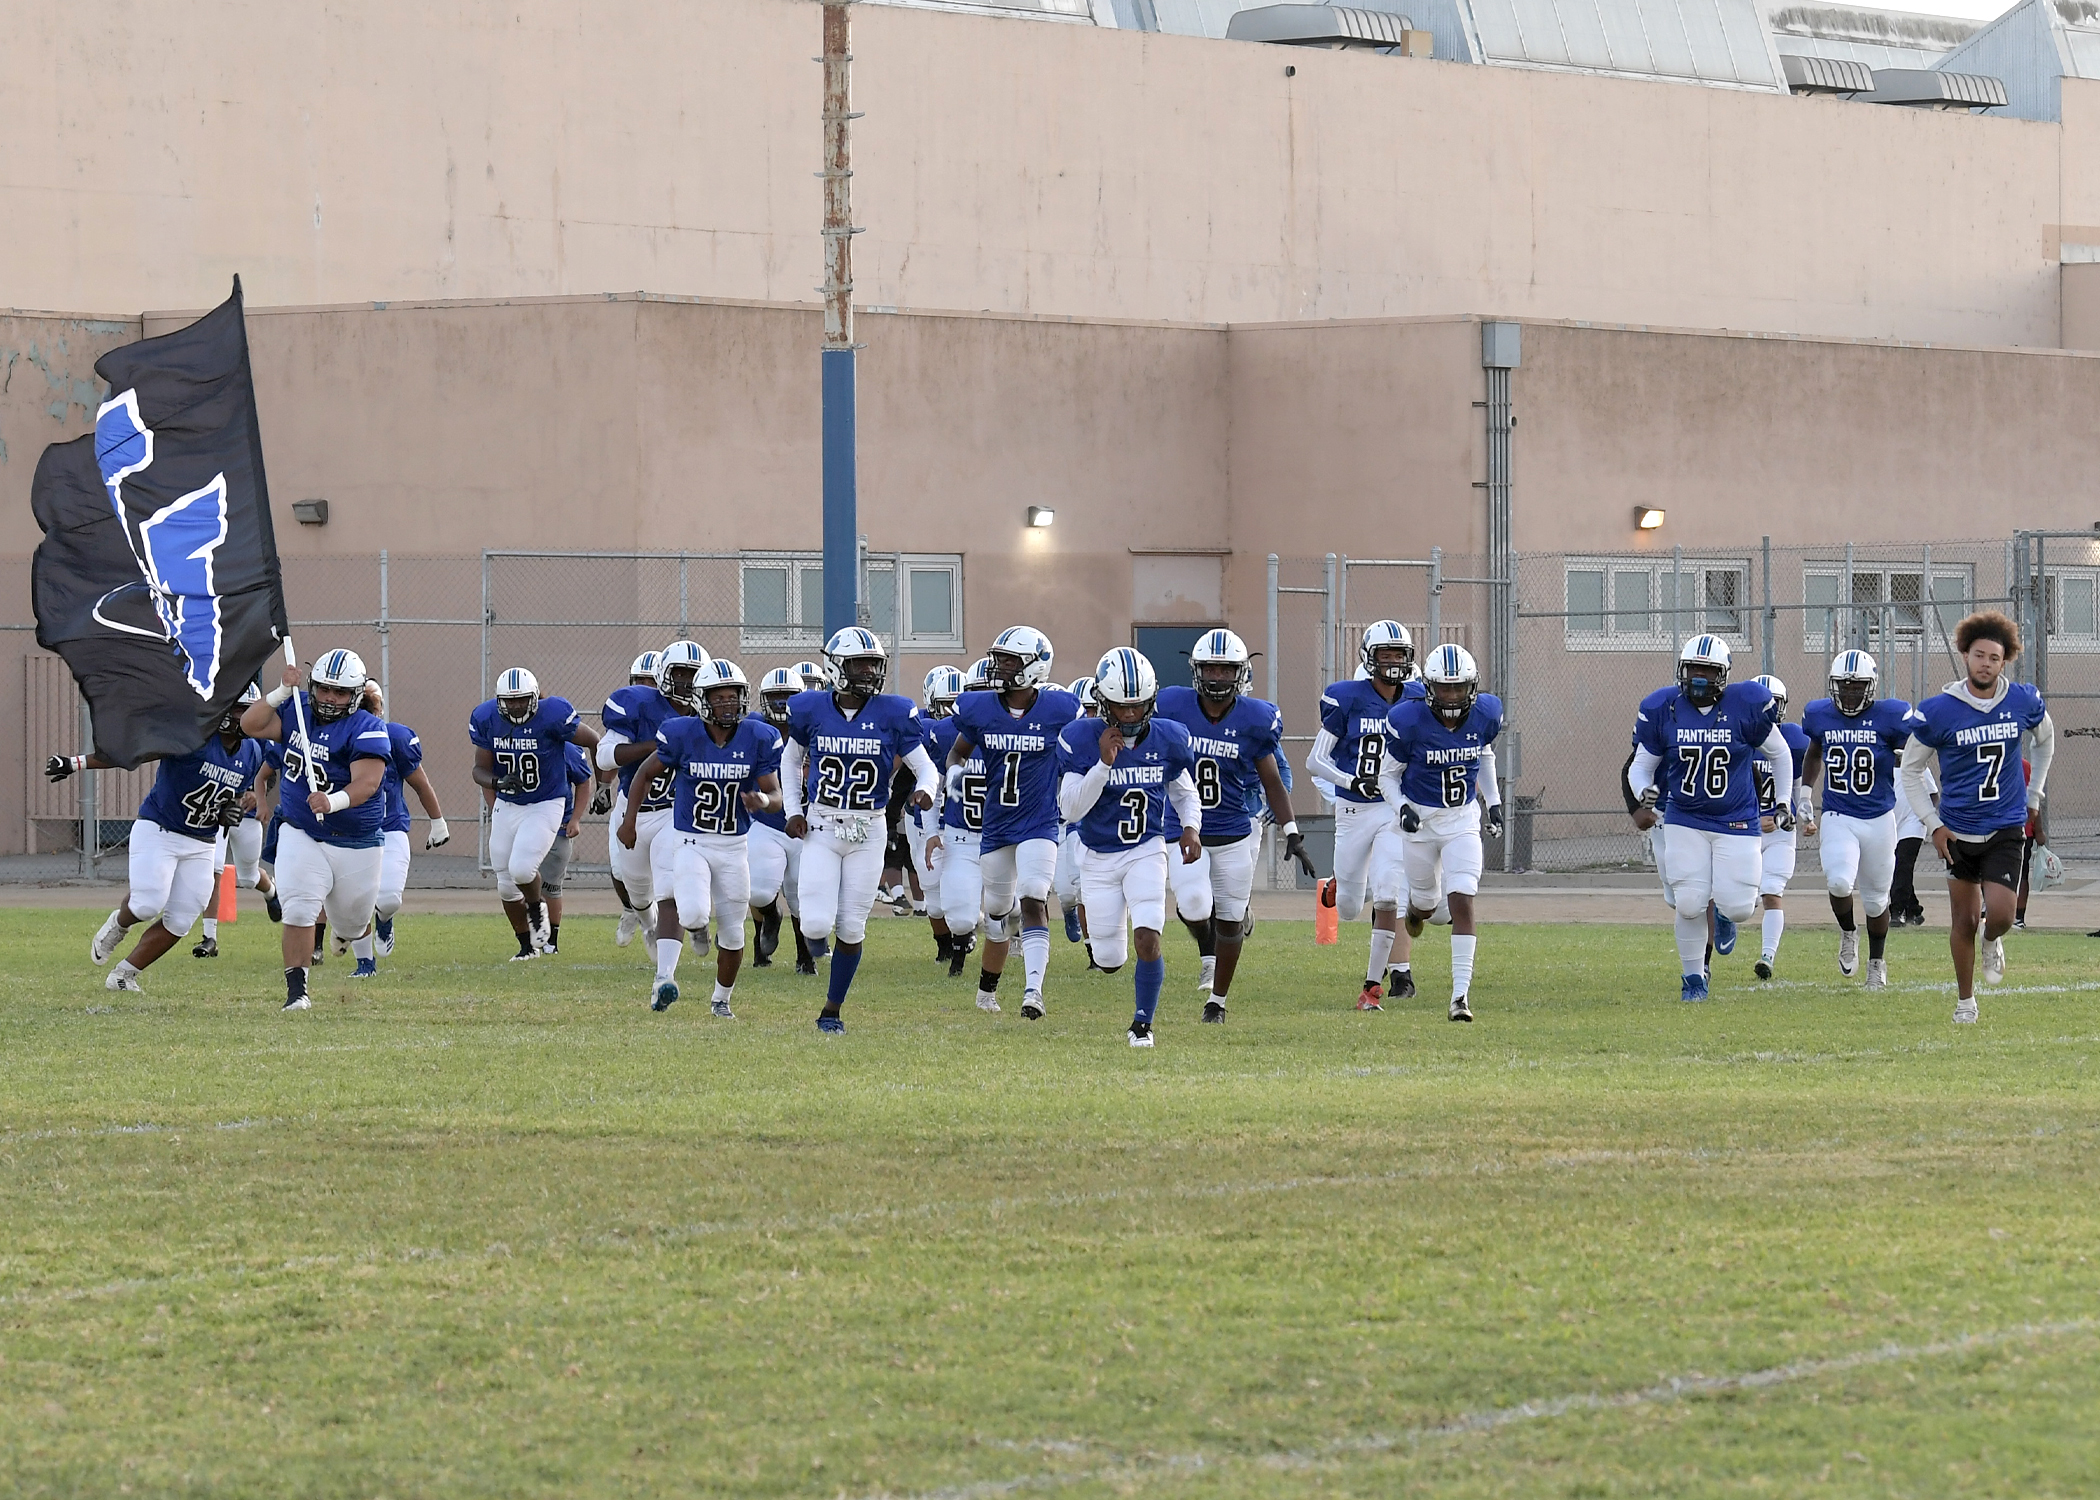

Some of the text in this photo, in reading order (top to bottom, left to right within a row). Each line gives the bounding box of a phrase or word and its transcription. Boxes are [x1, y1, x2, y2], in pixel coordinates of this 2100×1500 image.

[816, 735, 882, 756] PANTHERS
[983, 733, 1046, 752] PANTHERS
[1193, 735, 1240, 760] NTHERS
[1676, 728, 1732, 743] PANTHERS
[1824, 729, 1877, 744] PANTHERS
[1956, 721, 2019, 746] PANTHERS
[198, 761, 245, 788] PANTHERS
[496, 751, 541, 793] 78
[689, 761, 751, 780] PANTHERS
[814, 755, 879, 810] 22
[999, 751, 1022, 807] 1
[1108, 765, 1165, 786] ANTHERS
[1194, 756, 1223, 810] 8
[1441, 764, 1468, 809] 6
[1678, 745, 1731, 799] 76
[1825, 745, 1875, 796] 28
[1976, 741, 2006, 802] 7
[691, 780, 741, 835] 21
[1117, 787, 1149, 845] 3
